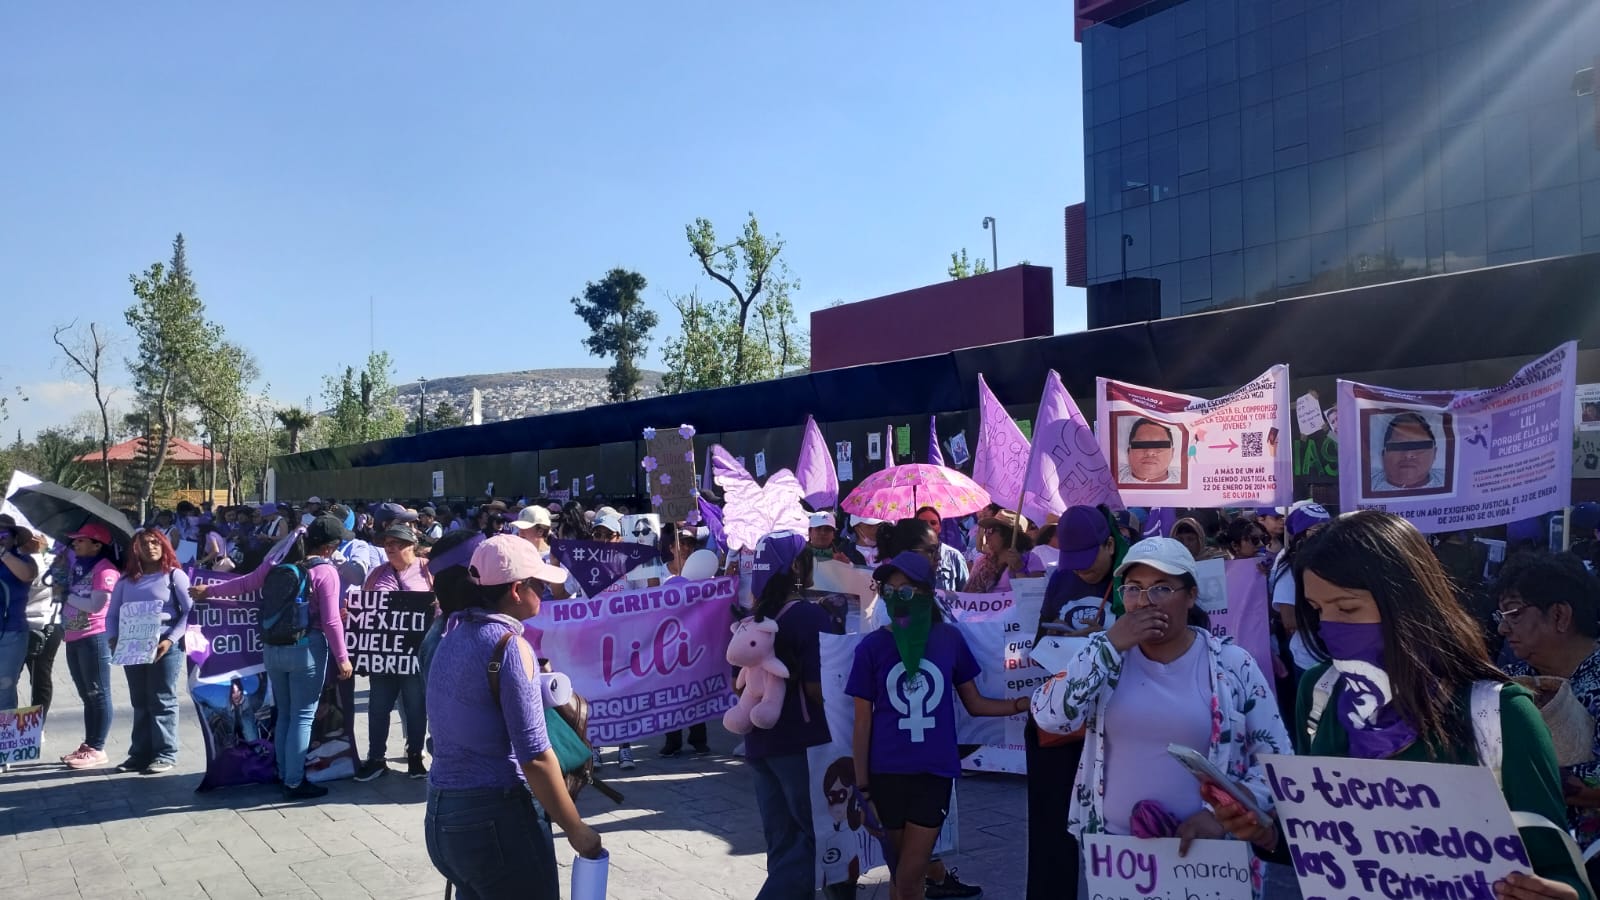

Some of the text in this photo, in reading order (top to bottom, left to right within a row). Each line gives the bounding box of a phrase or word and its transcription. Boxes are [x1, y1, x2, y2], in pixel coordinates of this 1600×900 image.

[1242, 403, 1278, 415] COMPROMISO
[1520, 412, 1537, 429] LILI
[1492, 431, 1522, 448] PORQUE
[1202, 475, 1239, 484] EXIGIENDO
[1268, 473, 1278, 482] EL
[1235, 466, 1244, 474] DE
[1245, 466, 1254, 474] UN
[1212, 483, 1221, 491] DE
[1222, 482, 1243, 491] ENERO
[1244, 482, 1253, 490] DE
[1266, 481, 1278, 490] NO
[1222, 491, 1231, 499] SE
[1232, 490, 1255, 499] OLVIDA
[1405, 509, 1416, 518] DE
[1416, 509, 1426, 518] UN
[1443, 503, 1481, 516] EXIGIENDO
[1512, 496, 1520, 505] EL
[1529, 492, 1538, 501] DE
[1537, 485, 1558, 499] ENERO
[1437, 515, 1447, 525] DE
[1465, 512, 1476, 522] NO
[1476, 510, 1487, 521] SE
[1486, 506, 1511, 518] OLVIDA
[348, 591, 390, 610] QUE
[553, 578, 733, 622] HOY GRITO POR
[193, 602, 222, 627] Tu
[346, 608, 426, 632] MÉXICO
[212, 633, 242, 655] en
[602, 619, 704, 687] Lili
[1009, 639, 1032, 653] que
[654, 683, 701, 707] ELLA
[704, 675, 726, 693] YA
[587, 716, 655, 741] PUEDE
[1264, 763, 1441, 811] le tienen
[1286, 817, 1363, 856] mas
[1173, 862, 1249, 883] marcho
[1289, 843, 1500, 900] las Feminist
